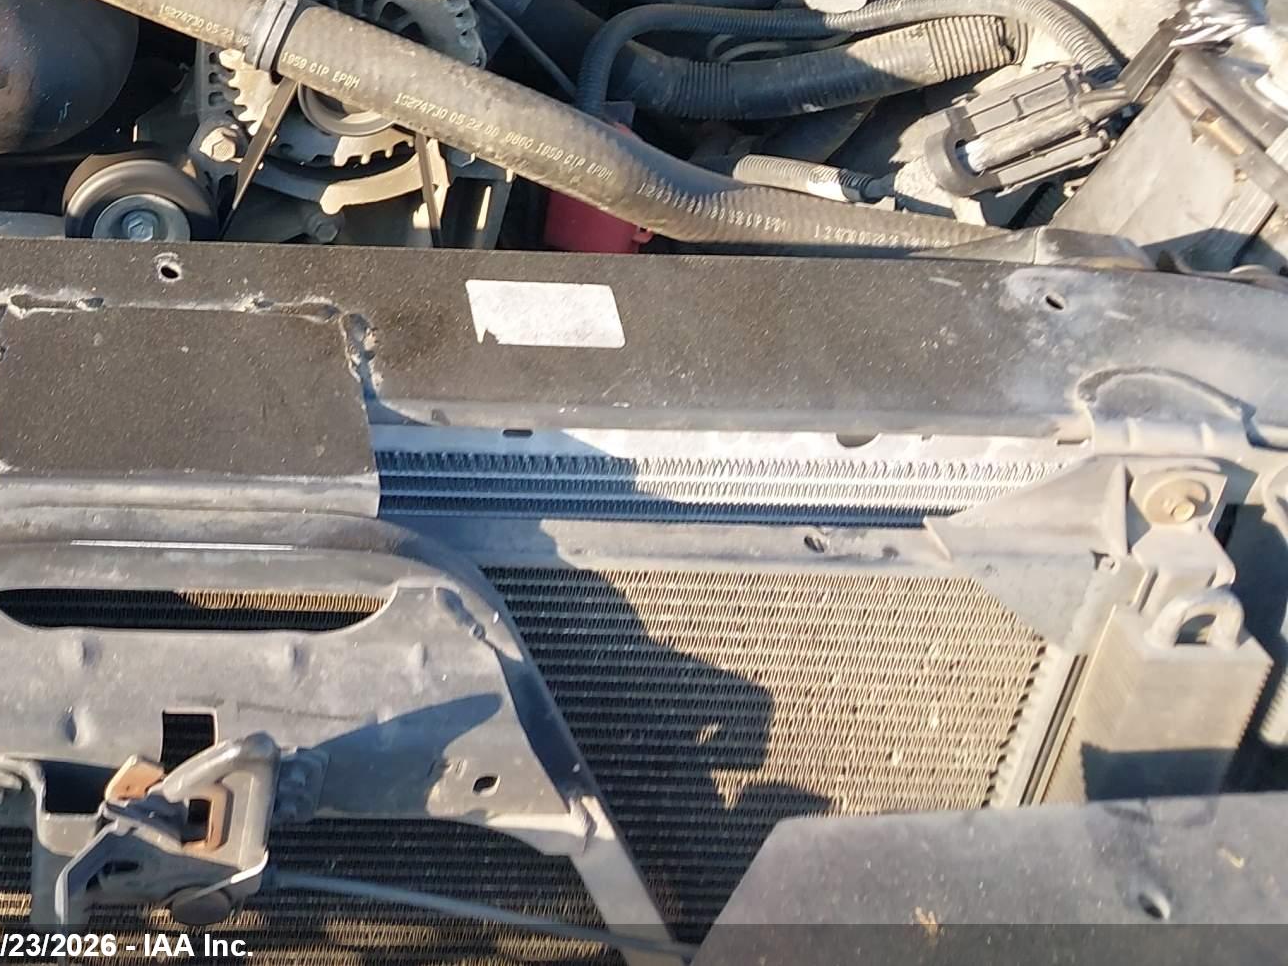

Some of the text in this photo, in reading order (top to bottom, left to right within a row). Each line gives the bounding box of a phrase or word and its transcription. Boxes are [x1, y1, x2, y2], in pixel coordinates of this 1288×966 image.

[280, 51, 361, 89] 1959 CIP EPDM
[393, 92, 448, 121] 15274730
[564, 153, 587, 170] CIP
